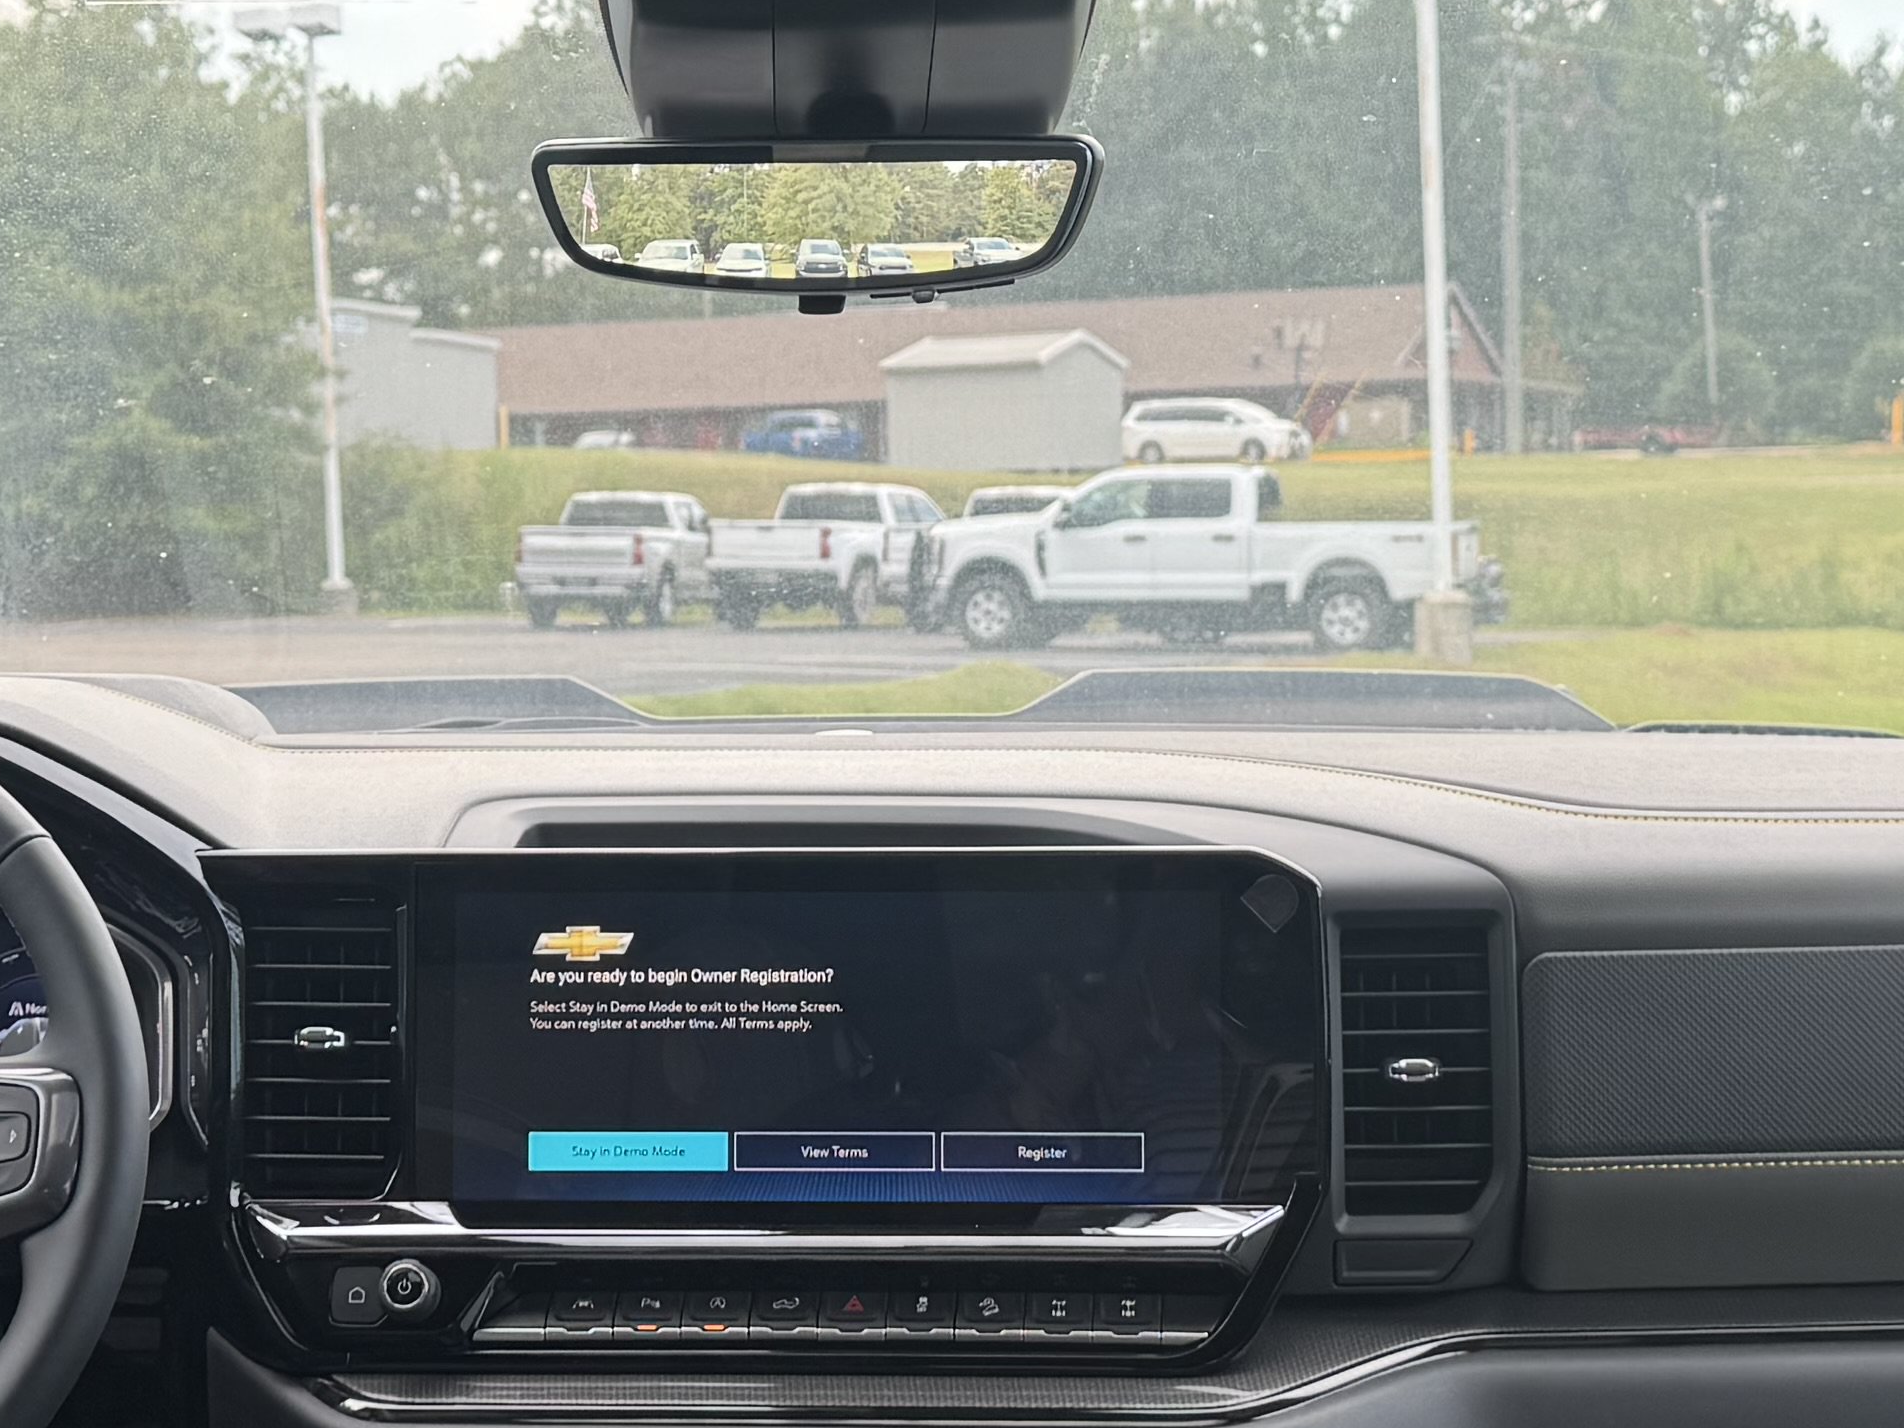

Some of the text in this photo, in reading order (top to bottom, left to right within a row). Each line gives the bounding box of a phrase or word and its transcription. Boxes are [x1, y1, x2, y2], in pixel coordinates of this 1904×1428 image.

[530, 968, 834, 986] Are you ready to begin Owner Registration?
[530, 1001, 843, 1016] Select Stay in Demo Mode to exit to the Home Screen.
[530, 1018, 812, 1033] You can register at another time. All Terms apply.
[572, 1145, 686, 1160] Stay in Demo Mode
[801, 1146, 868, 1158] View Terms
[1018, 1146, 1067, 1160] Register
